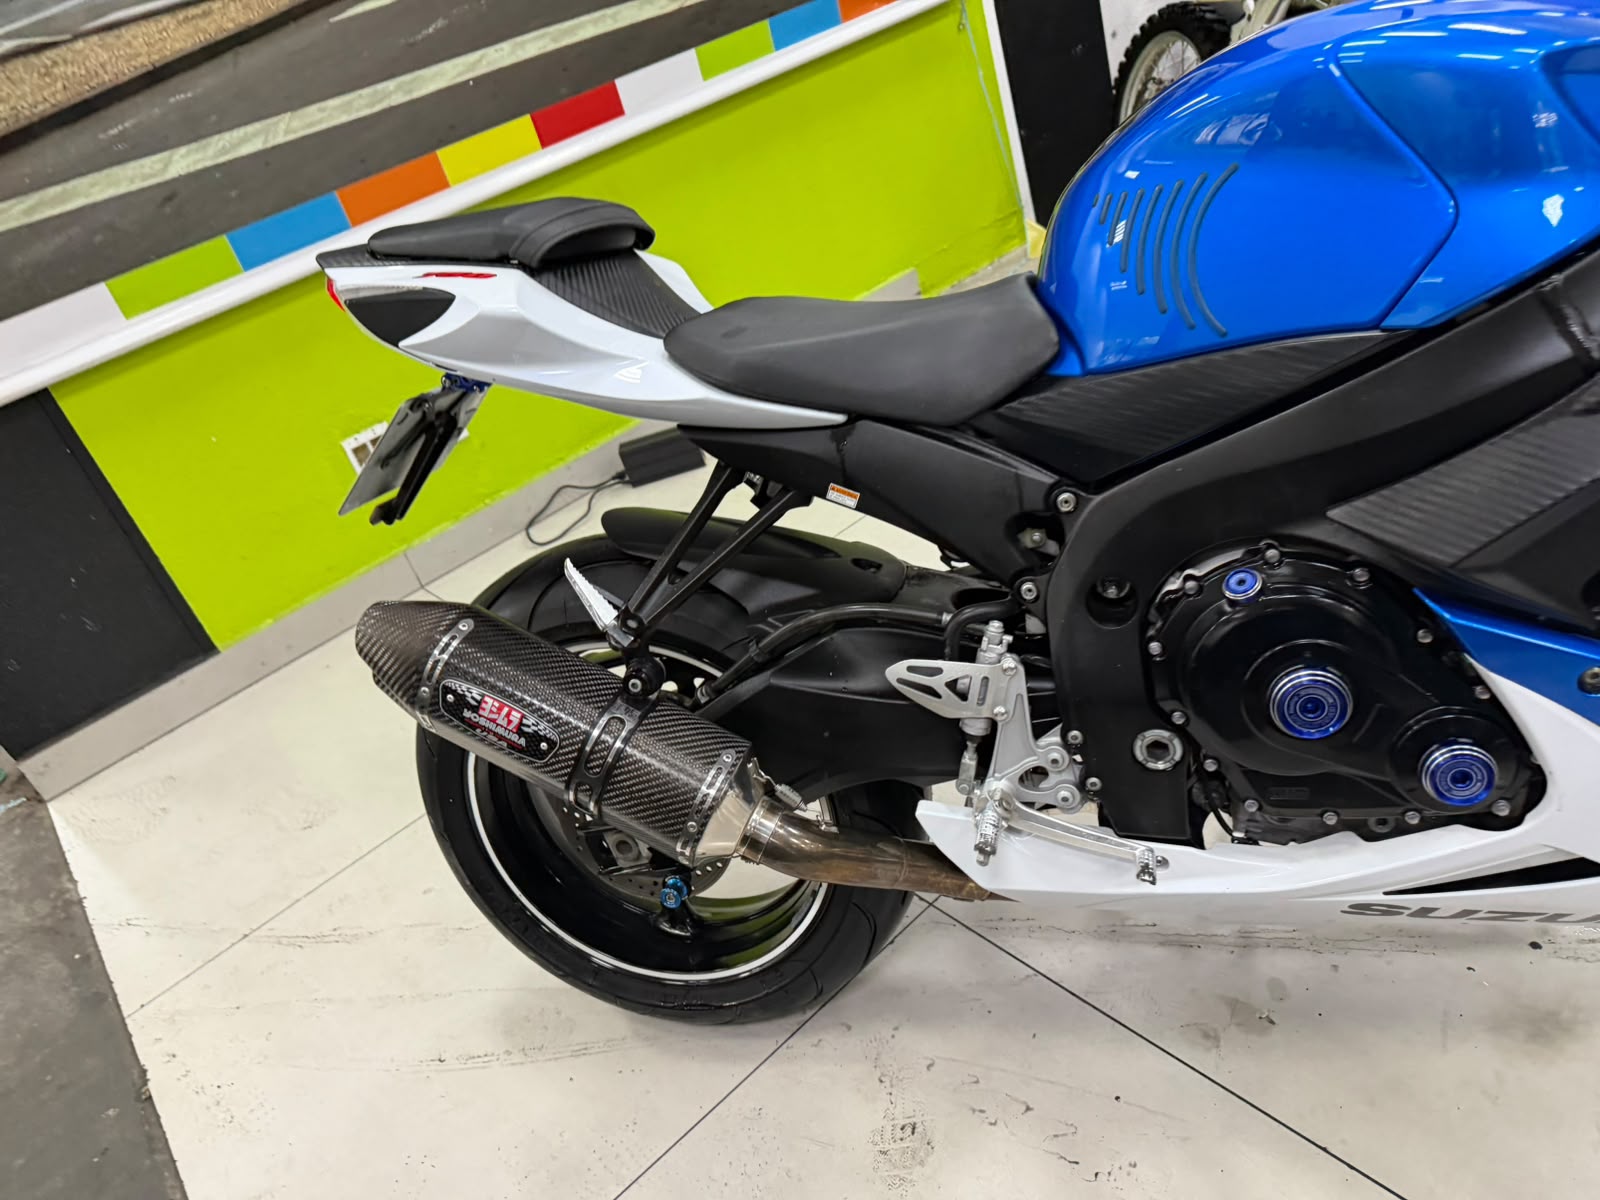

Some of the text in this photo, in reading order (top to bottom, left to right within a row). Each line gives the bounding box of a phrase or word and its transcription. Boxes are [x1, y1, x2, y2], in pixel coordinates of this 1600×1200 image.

[463, 708, 526, 747] YOSHIMURA
[479, 694, 522, 733] ヨシムラ
